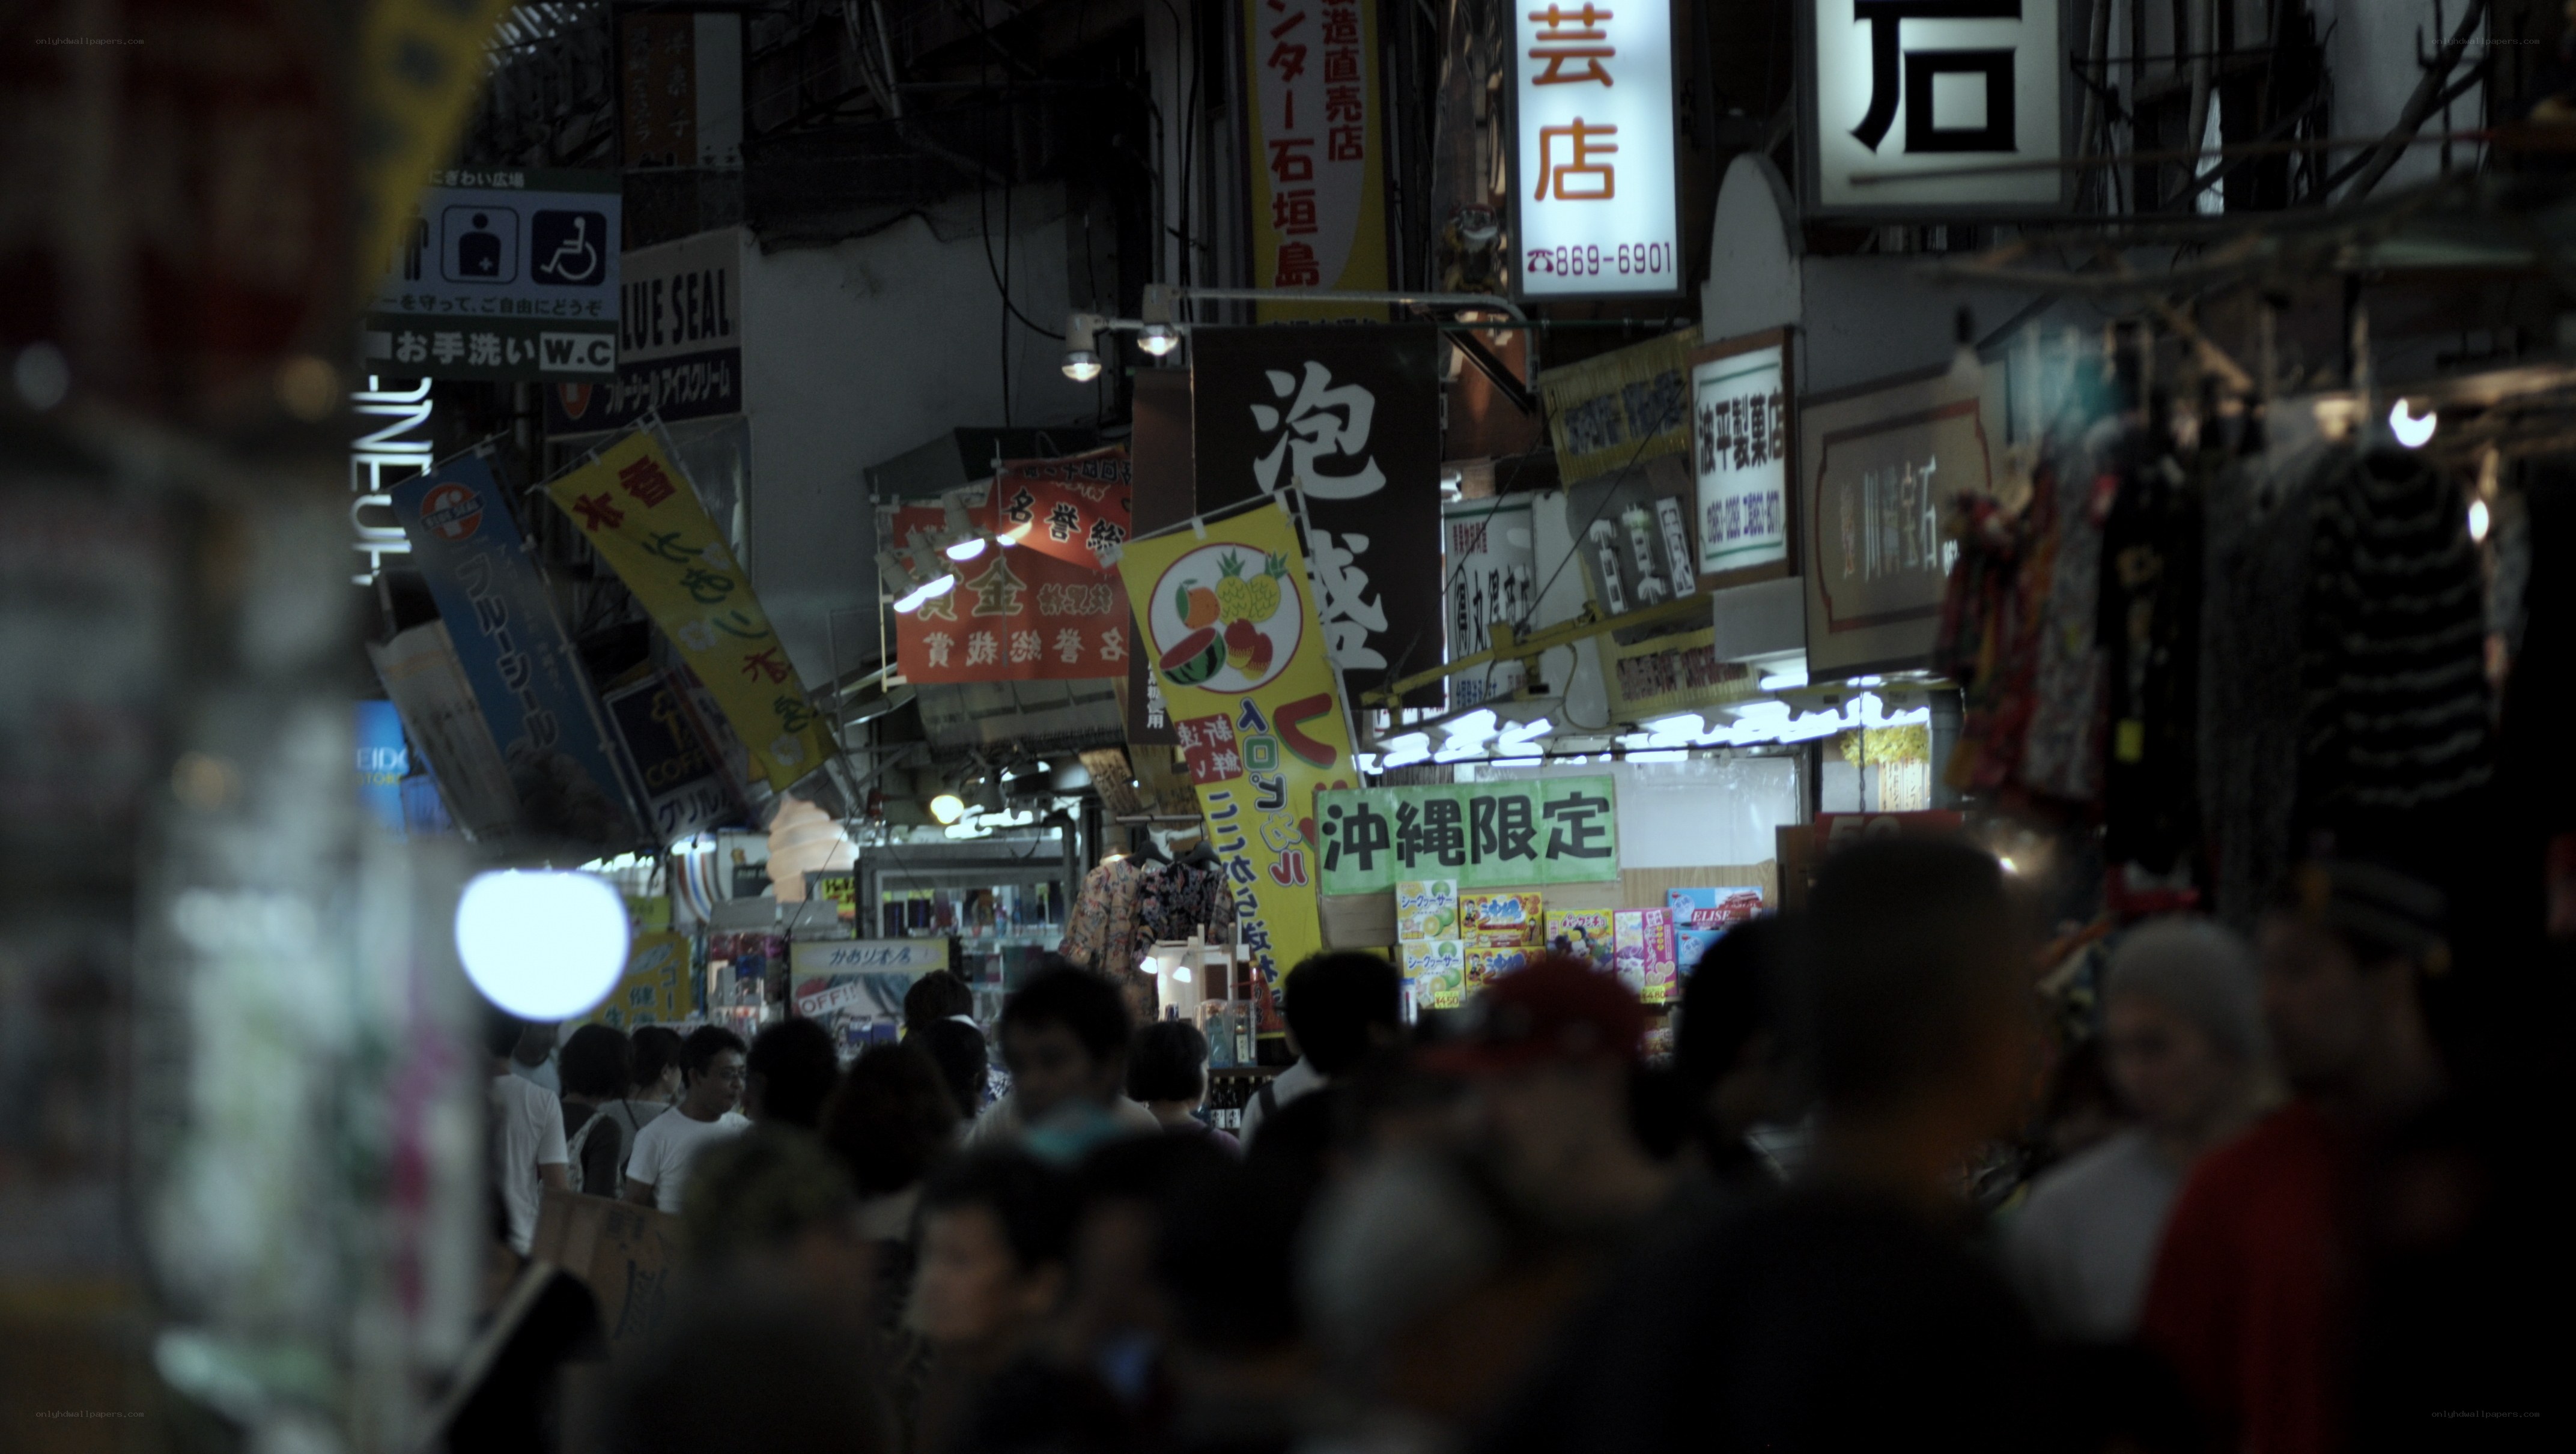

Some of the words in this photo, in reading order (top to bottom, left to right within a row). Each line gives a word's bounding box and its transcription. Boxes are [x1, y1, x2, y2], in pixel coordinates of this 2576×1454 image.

[1322, 0, 1363, 161] 造直売店
[1528, 2, 1618, 202] 芸店
[1556, 242, 1671, 276] 869-6901
[672, 268, 729, 345] SEAL
[396, 330, 535, 366] お手洗い
[545, 334, 612, 365] W.C
[1322, 792, 1612, 871] 沖縄限定
[1693, 909, 1731, 922] ELISE
